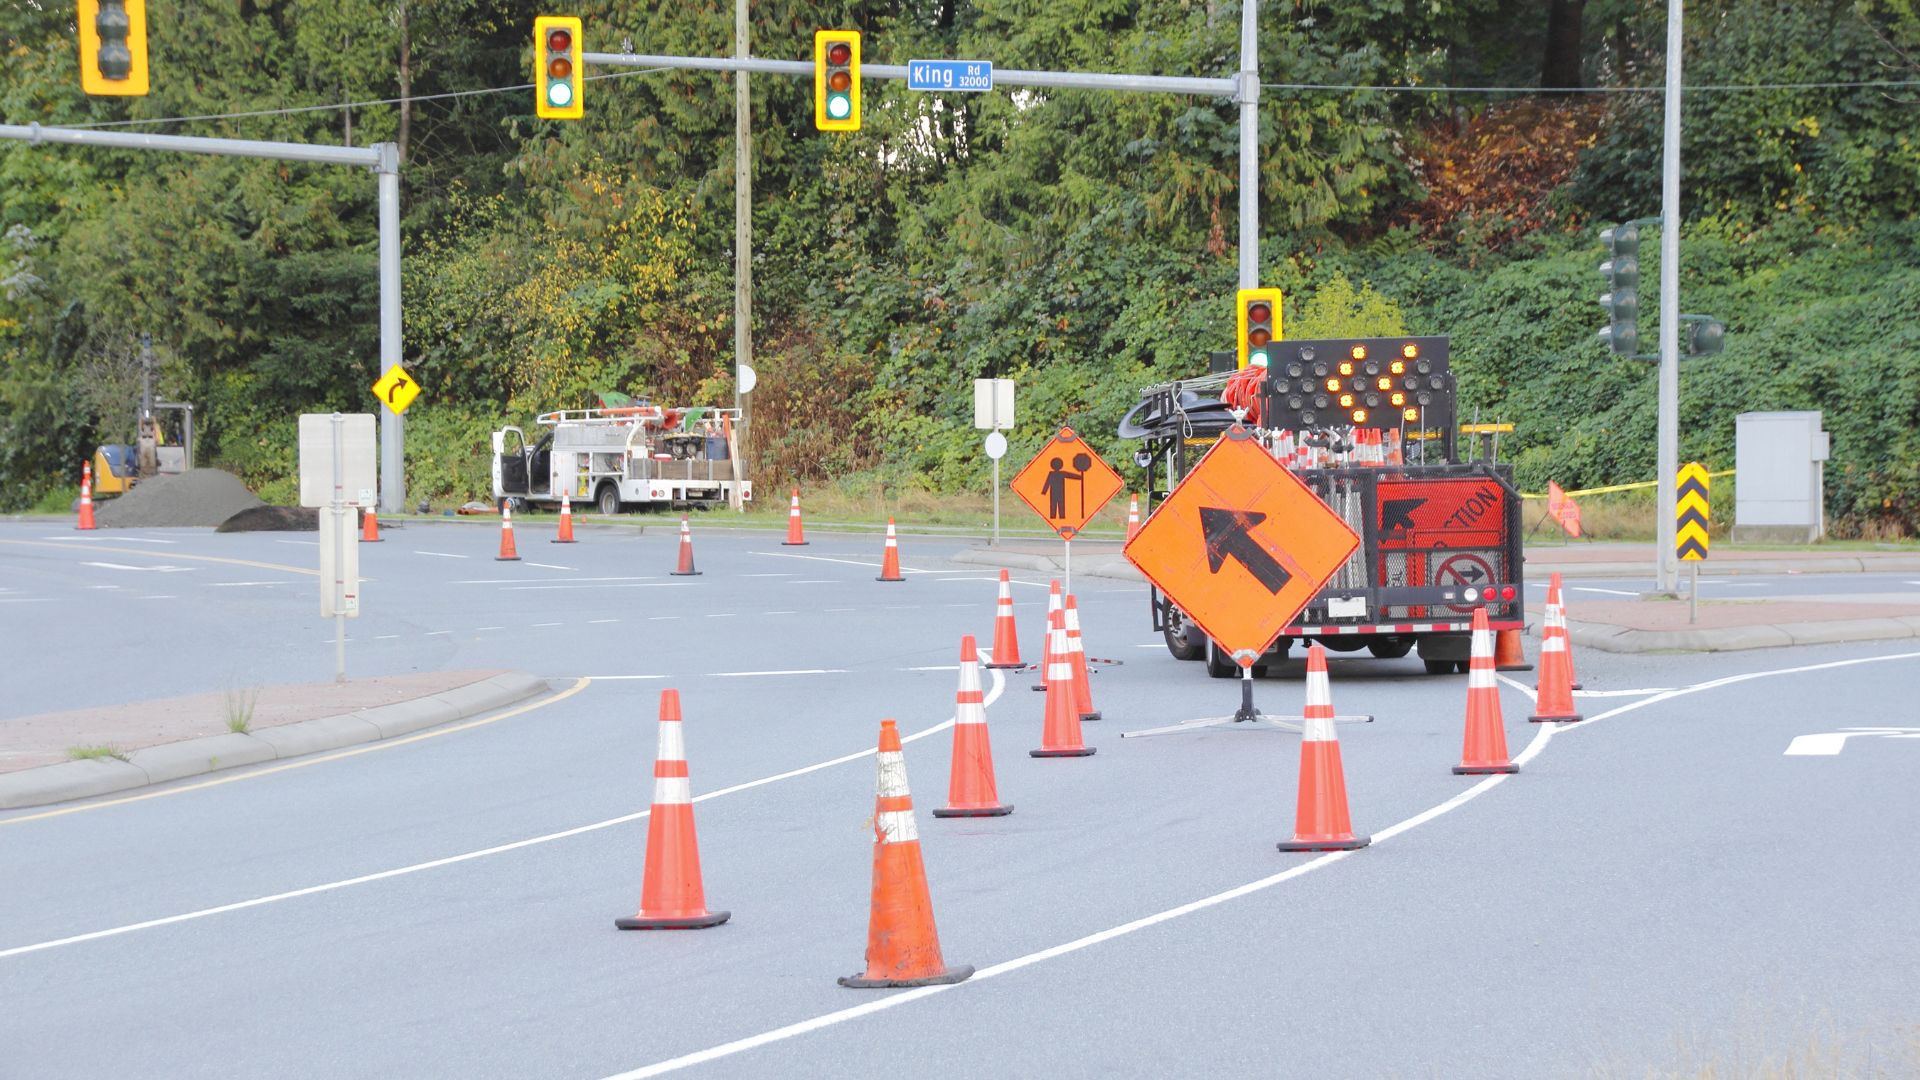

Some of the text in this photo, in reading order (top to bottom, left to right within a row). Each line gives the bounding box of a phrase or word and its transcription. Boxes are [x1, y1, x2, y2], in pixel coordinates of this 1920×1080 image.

[914, 65, 980, 87] King Rd
[960, 76, 988, 87] 32000
